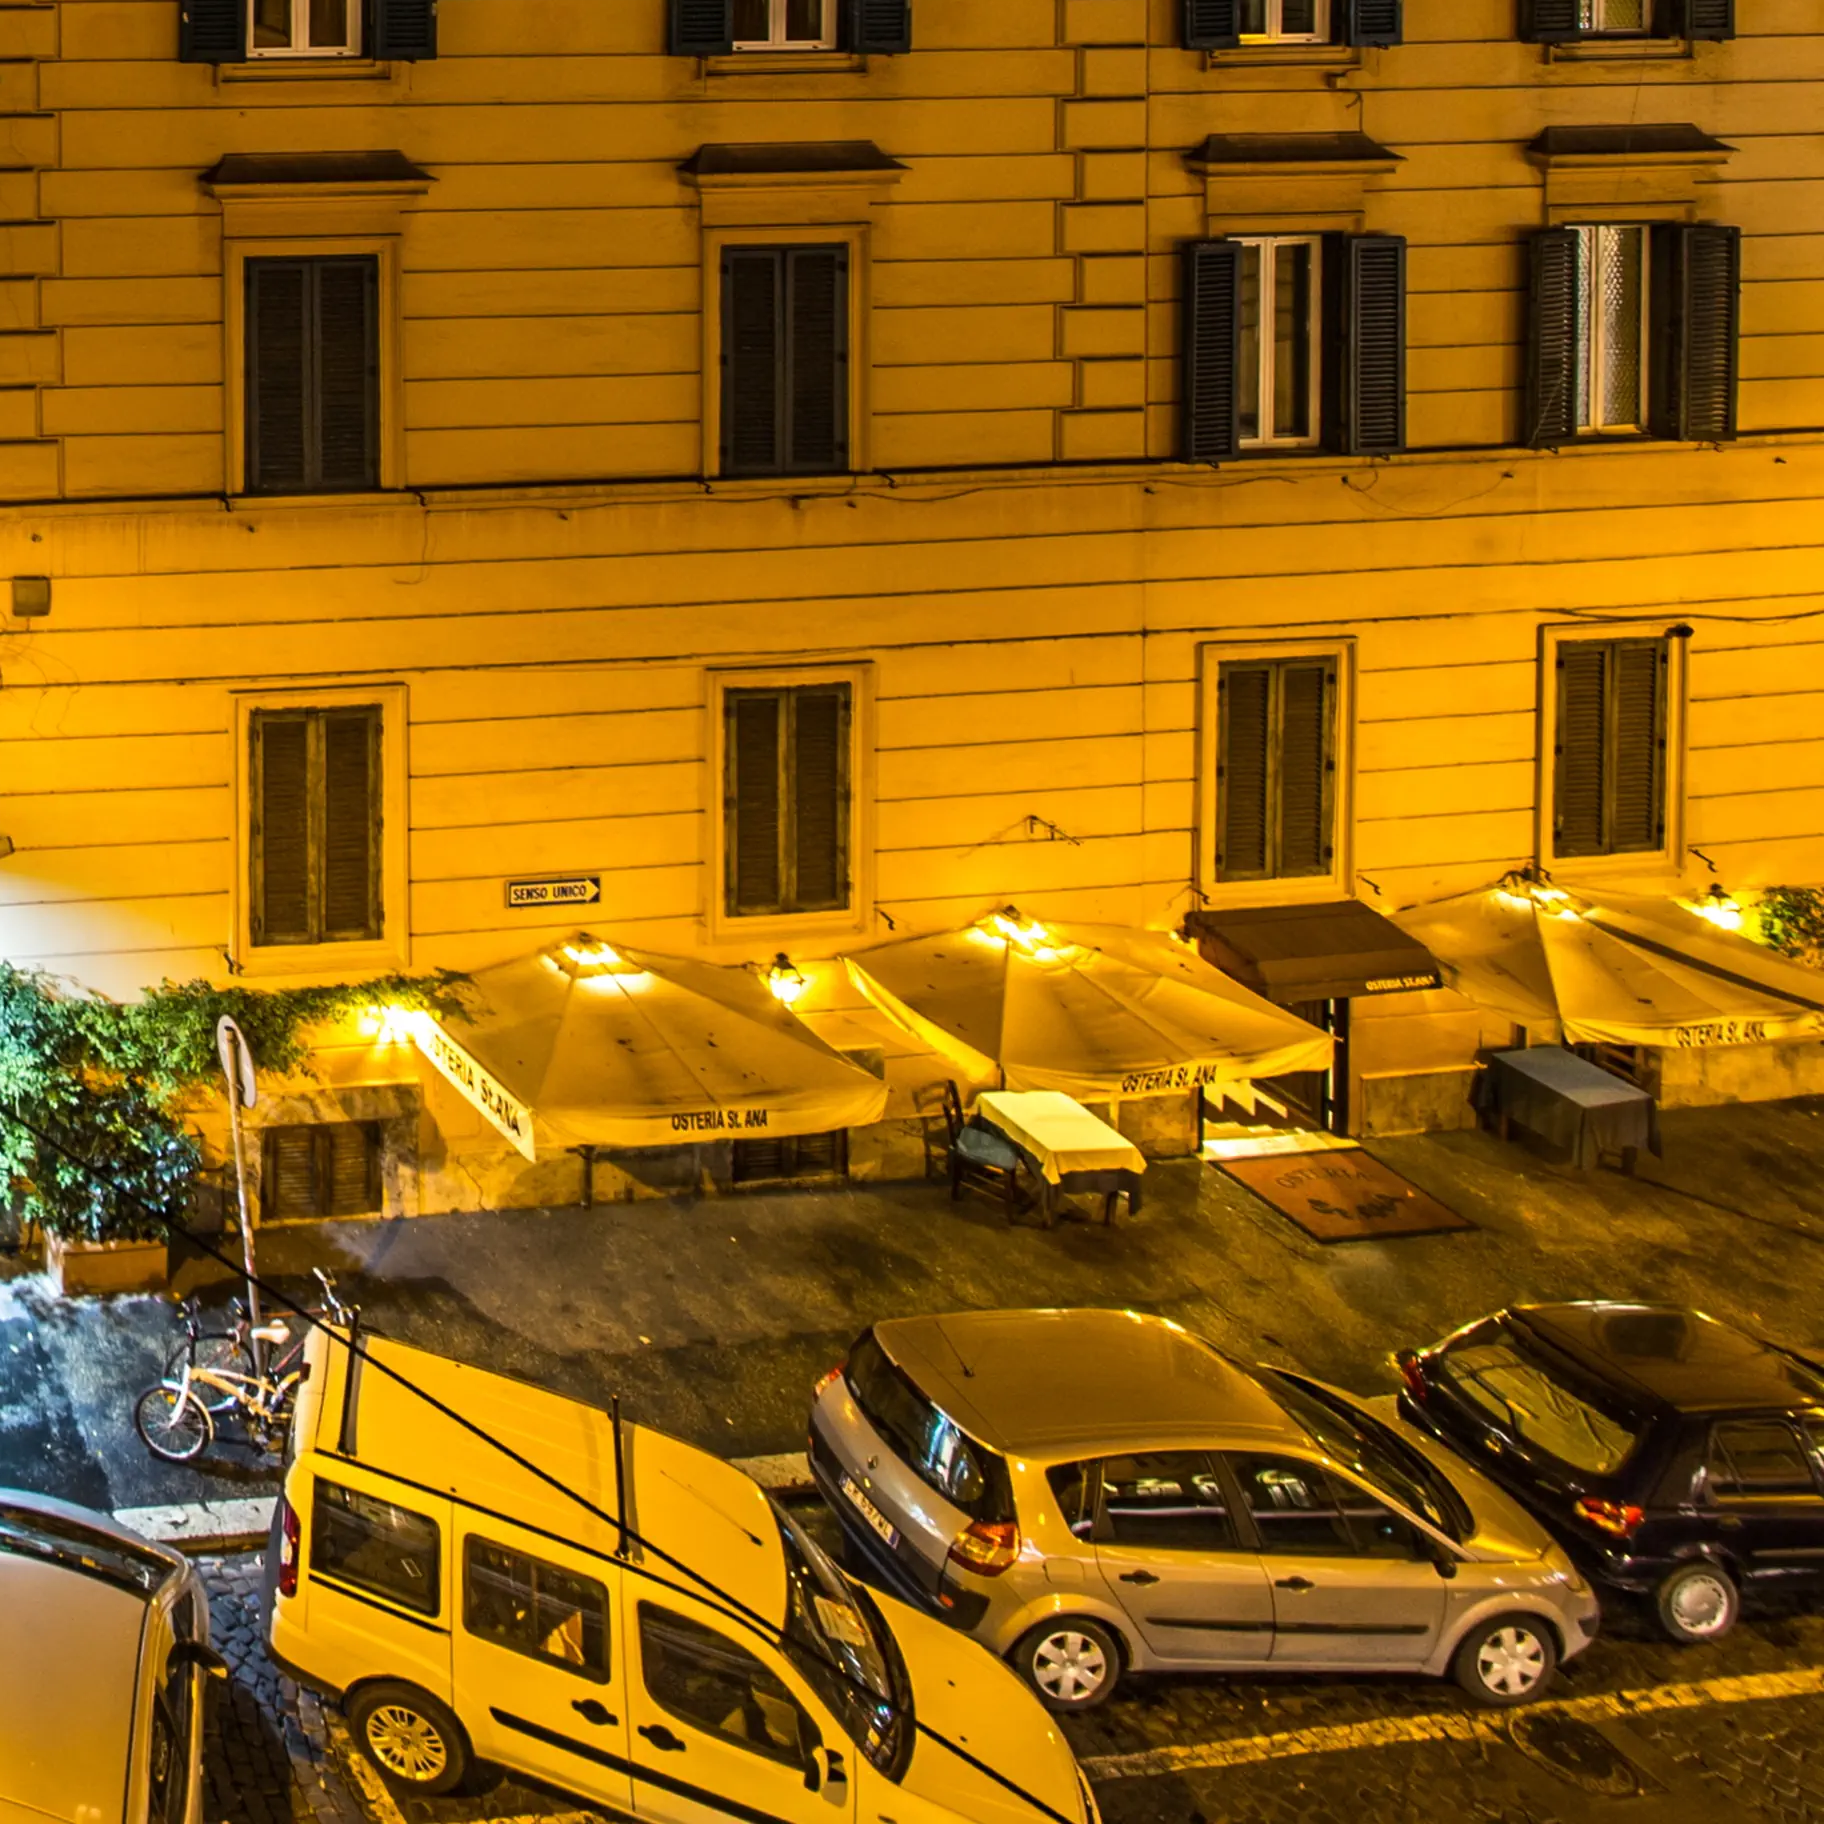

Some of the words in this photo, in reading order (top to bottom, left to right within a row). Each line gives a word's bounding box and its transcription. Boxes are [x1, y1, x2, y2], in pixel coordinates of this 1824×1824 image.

[513, 887, 548, 901] SENSO
[553, 884, 587, 898] UNICO
[1365, 977, 1403, 991] OSTERIA
[1676, 1023, 1723, 1048] OSTERIA
[1743, 1020, 1766, 1042] ANA
[426, 1026, 474, 1092] STERIA
[1121, 1069, 1173, 1092] OSTERIA
[1192, 1064, 1217, 1085] ANA
[672, 1110, 725, 1131] OSTERIA
[744, 1108, 768, 1128] ANA
